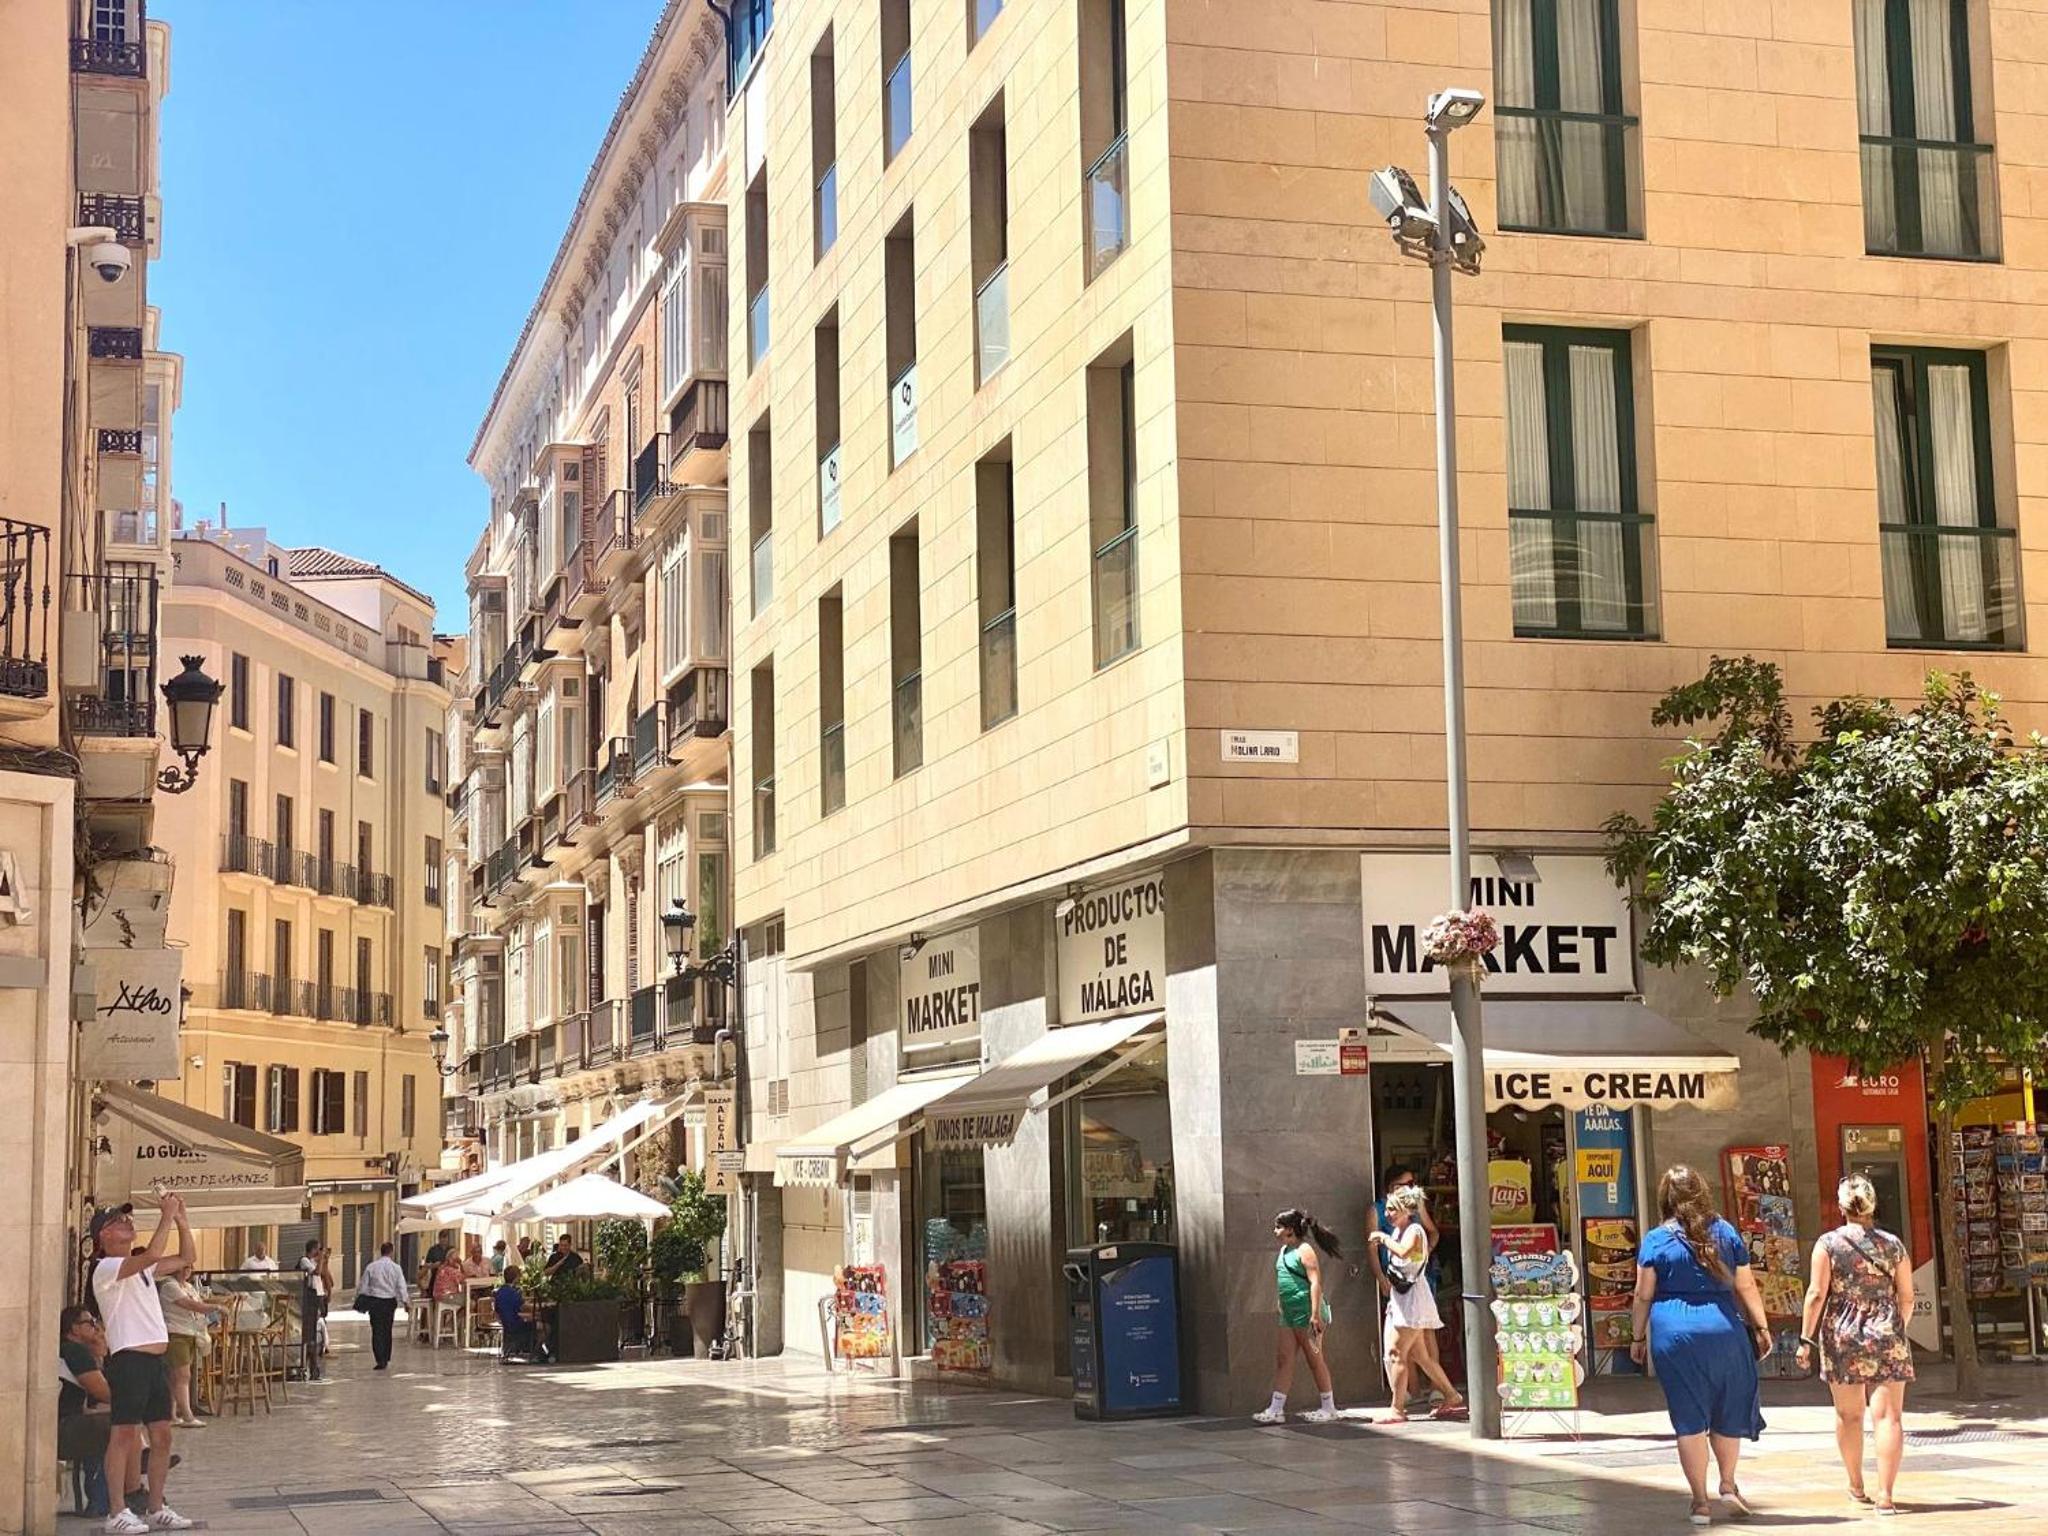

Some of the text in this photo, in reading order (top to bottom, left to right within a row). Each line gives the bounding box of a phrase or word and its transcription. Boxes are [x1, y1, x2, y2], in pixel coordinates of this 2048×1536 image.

[1231, 745, 1258, 755] MOLINA
[929, 950, 954, 979] MINI
[1104, 933, 1127, 968] DE
[97, 980, 172, 1017] Atlas
[1081, 970, 1154, 1014] MÁLAGA
[907, 982, 980, 1034] MARKET
[1494, 1073, 1550, 1100] ICE
[1584, 1073, 1704, 1100] CREAM
[935, 1118, 960, 1140] VINOS
[962, 1117, 974, 1139] DE
[136, 1146, 155, 1159] LO
[200, 1174, 217, 1185] DE
[218, 1173, 269, 1184] CARNES
